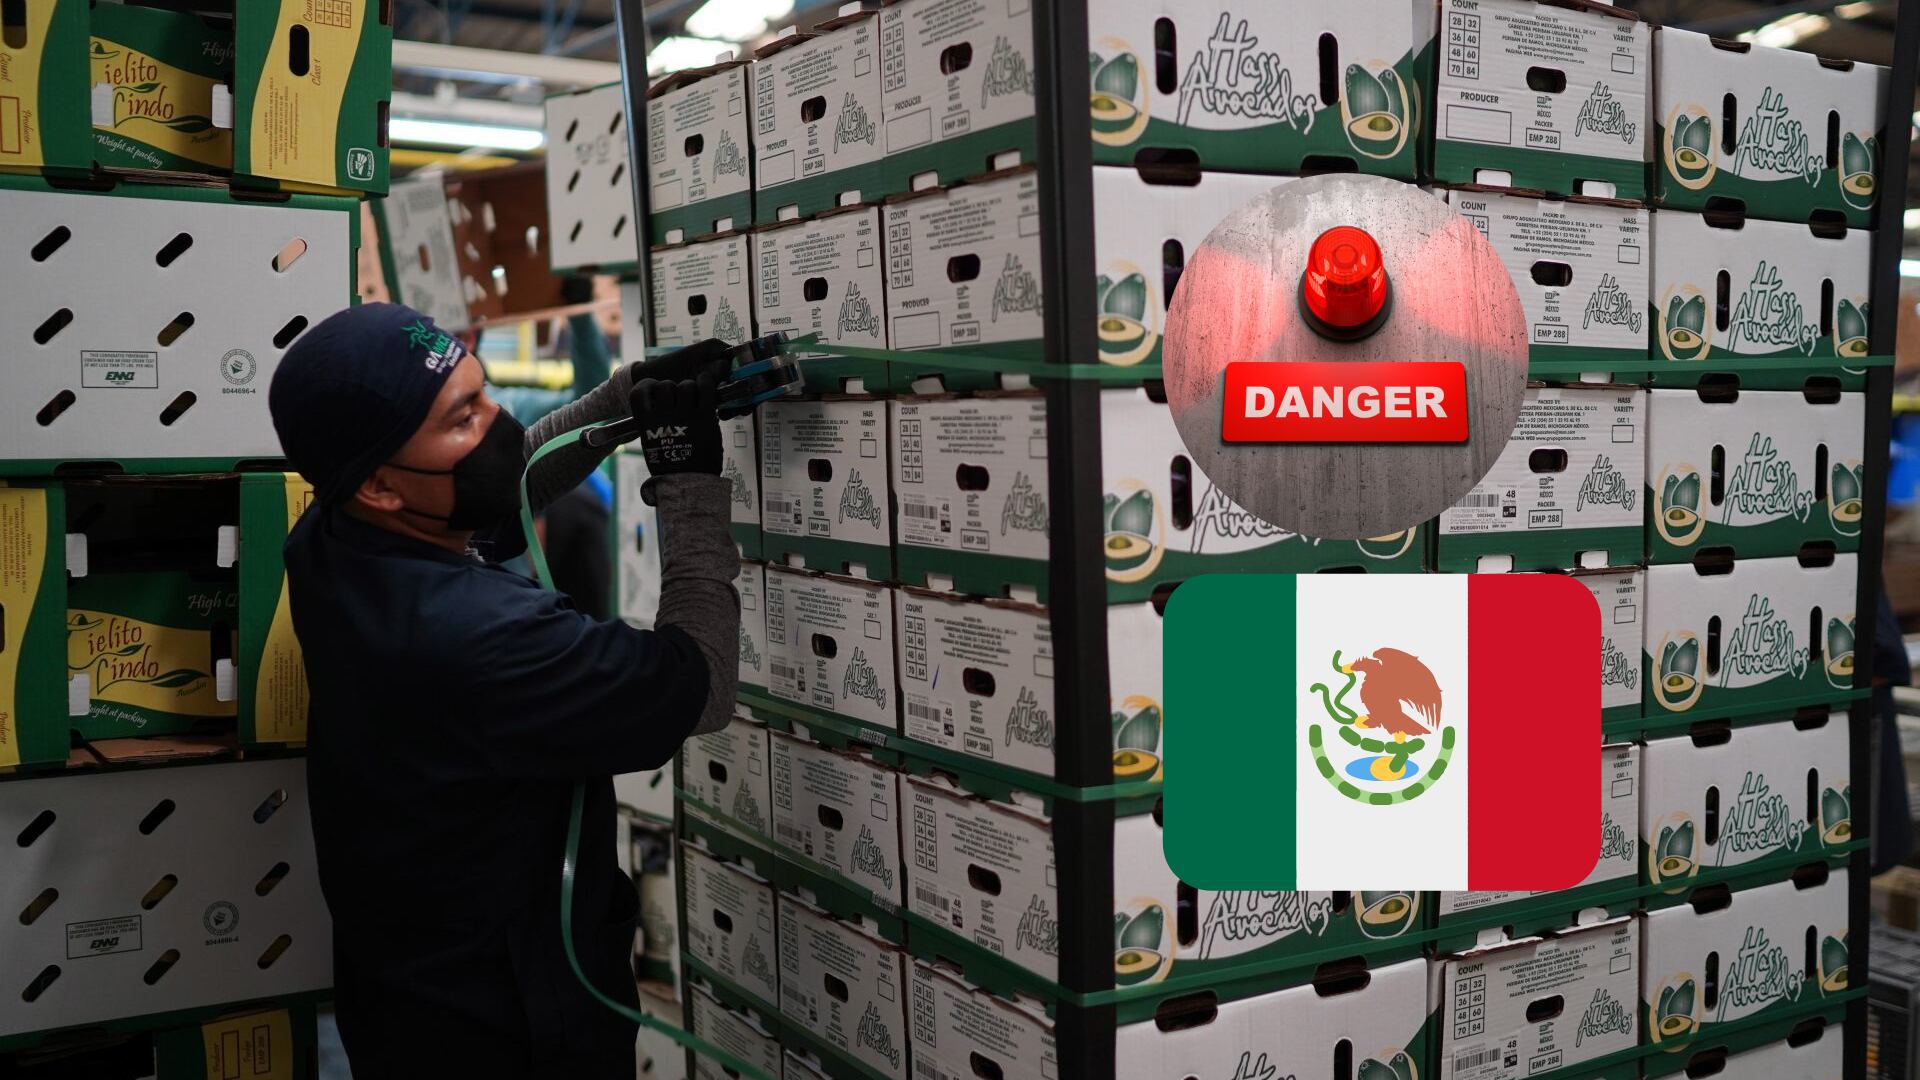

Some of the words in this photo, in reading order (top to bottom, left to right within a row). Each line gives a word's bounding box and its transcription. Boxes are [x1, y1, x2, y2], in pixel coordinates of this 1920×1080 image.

[302, 0, 314, 21] Coun
[1452, 0, 1478, 10] COUNT
[885, 11, 901, 24] COUNT
[1452, 17, 1462, 26] 28
[1467, 19, 1477, 28] 32
[1617, 26, 1631, 34] HASS
[1452, 33, 1462, 41] 36
[1466, 35, 1477, 44] 40
[1613, 34, 1634, 43] VARIETY
[1208, 12, 1280, 95] Hass
[1452, 48, 1461, 57] 48
[1466, 51, 1476, 59] 60
[311, 64, 321, 86] Class
[1451, 64, 1461, 73] 70
[1466, 66, 1475, 75] 84
[1177, 50, 1317, 136] Avocados
[1460, 91, 1499, 104] PRODUCER
[894, 96, 921, 111] PRODUCER
[1589, 81, 1621, 122] Hass
[1535, 120, 1553, 128] PACKER
[1575, 100, 1635, 144] Avocados
[1756, 86, 1802, 154] Hass
[1529, 134, 1544, 143] EMP
[1545, 136, 1558, 144] 288
[97, 134, 126, 152] Weight
[126, 145, 134, 154] at
[132, 147, 163, 170] packing
[1733, 117, 1824, 188] Avocados
[1461, 201, 1487, 211] COUNT
[890, 210, 908, 220] COUNT
[1598, 273, 1627, 311] Hass
[1750, 260, 1799, 324] Hass
[902, 298, 929, 309] PRODUCER
[1583, 292, 1642, 334] Avocados
[1728, 292, 1819, 356] Avocados
[1537, 329, 1552, 338] EMP
[1553, 330, 1566, 338] 288
[901, 407, 918, 415] COUNT
[646, 425, 688, 440] MAX
[1745, 431, 1790, 496] Hass
[1591, 453, 1621, 494] Hass
[1506, 490, 1516, 498] 48
[1577, 474, 1636, 512] Avocados
[1723, 465, 1814, 525] Avocados
[1532, 515, 1546, 523] EMP
[1548, 515, 1560, 523] 288
[963, 535, 975, 544] EMP
[1619, 578, 1633, 586] HASS
[1615, 586, 1637, 595] VARIETY
[188, 591, 222, 617] High
[906, 604, 923, 613] COUNT
[1743, 593, 1788, 657] Hass
[1720, 627, 1810, 688] Avocados
[109, 707, 117, 716] at
[116, 708, 147, 728] packing
[967, 739, 978, 748] EMP
[1613, 760, 1633, 769] VARIETY
[915, 794, 934, 806] COUNT
[1738, 771, 1782, 834] Hass
[1715, 806, 1803, 867] Avocados
[1200, 894, 1332, 960] Avocados
[1611, 936, 1631, 945] VARIETY
[1738, 926, 1782, 987] Hass
[915, 968, 932, 982] COUNT
[1458, 963, 1484, 975] COUNT
[1458, 982, 1468, 991] 28
[1473, 980, 1482, 989] 32
[1715, 960, 1803, 1023] Avocados
[1458, 998, 1467, 1006] 36
[1473, 994, 1482, 1002] 40
[1590, 988, 1620, 1022] Hass
[1458, 1012, 1467, 1020] 48
[1472, 1008, 1481, 1016] 60
[1457, 1026, 1467, 1035] 70
[1472, 1024, 1481, 1032] 84
[1576, 1007, 1633, 1048] Avocados
[1507, 1040, 1517, 1048] 48
[1538, 1044, 1555, 1053] PACKER
[1532, 1060, 1546, 1070] EMP
[1547, 1056, 1560, 1066] 288
